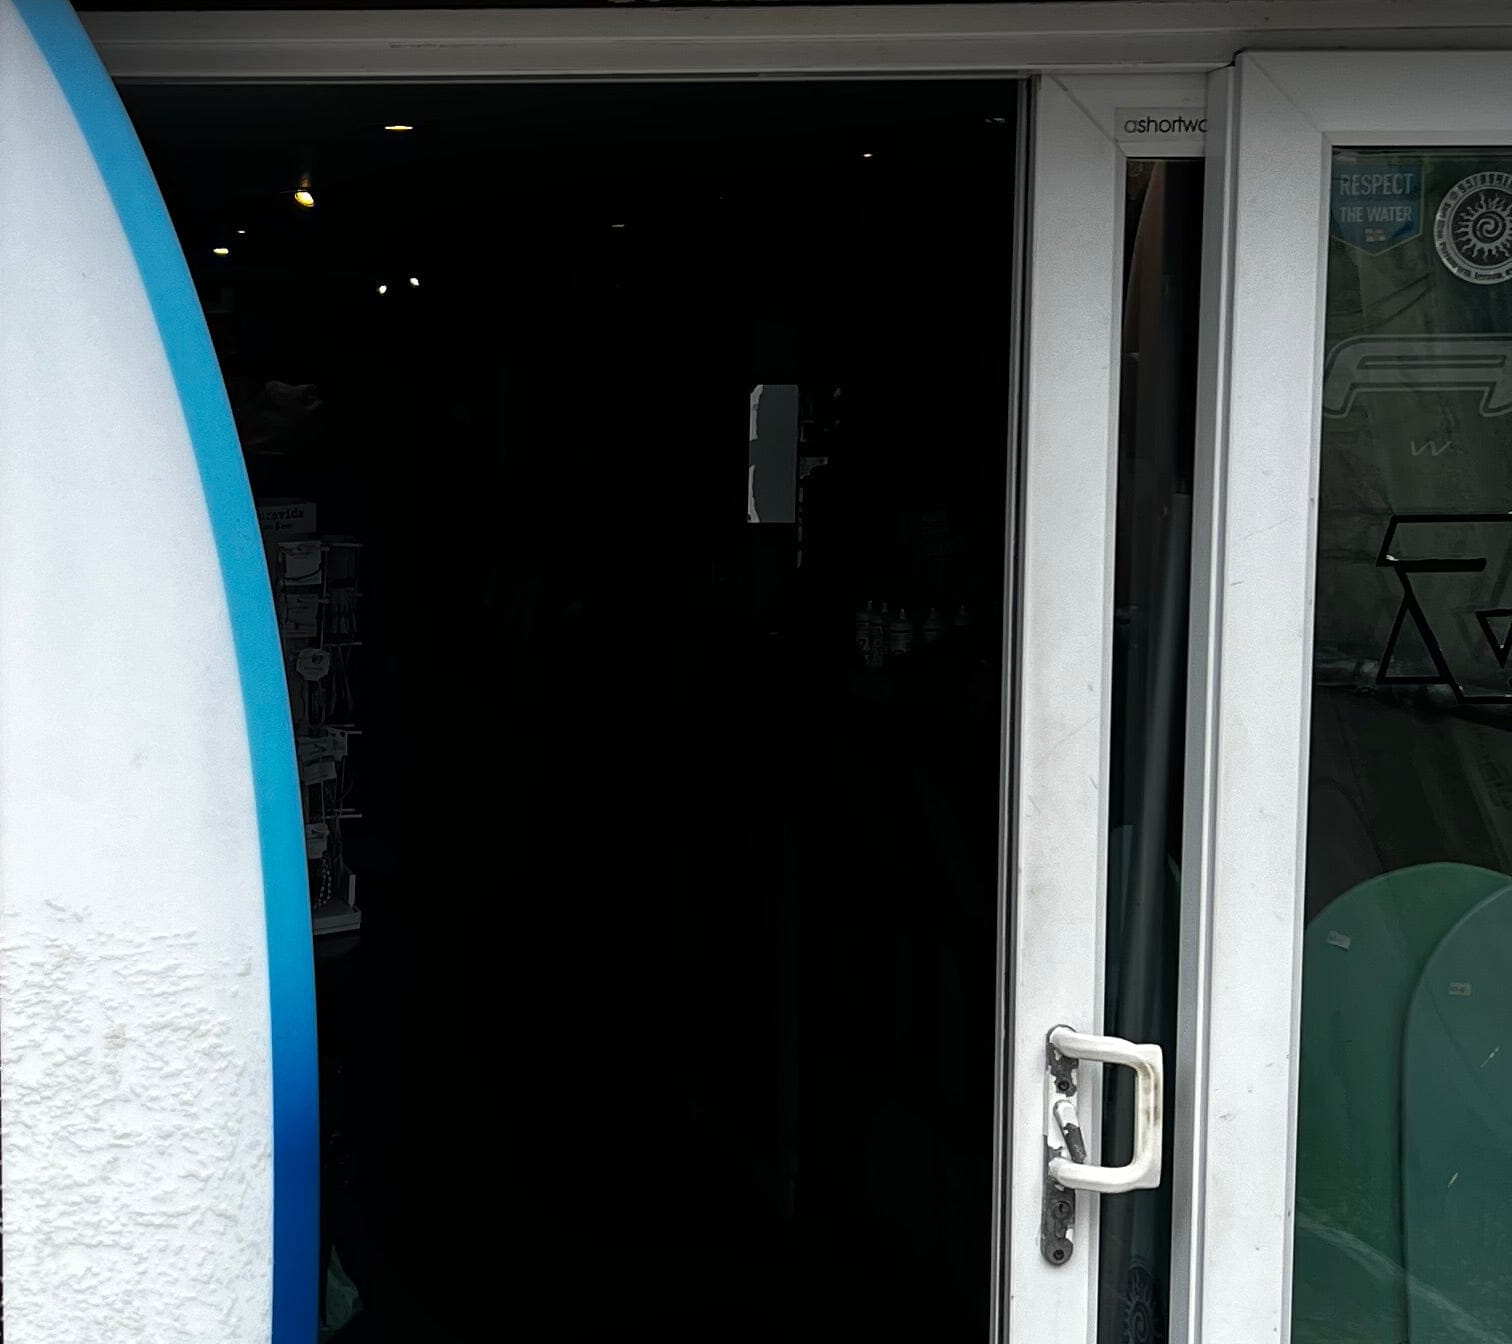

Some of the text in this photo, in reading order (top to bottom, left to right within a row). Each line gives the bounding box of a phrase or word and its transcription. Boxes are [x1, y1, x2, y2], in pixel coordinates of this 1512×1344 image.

[1339, 173, 1413, 195] RESPECT
[1339, 206, 1412, 222] THE WATER
